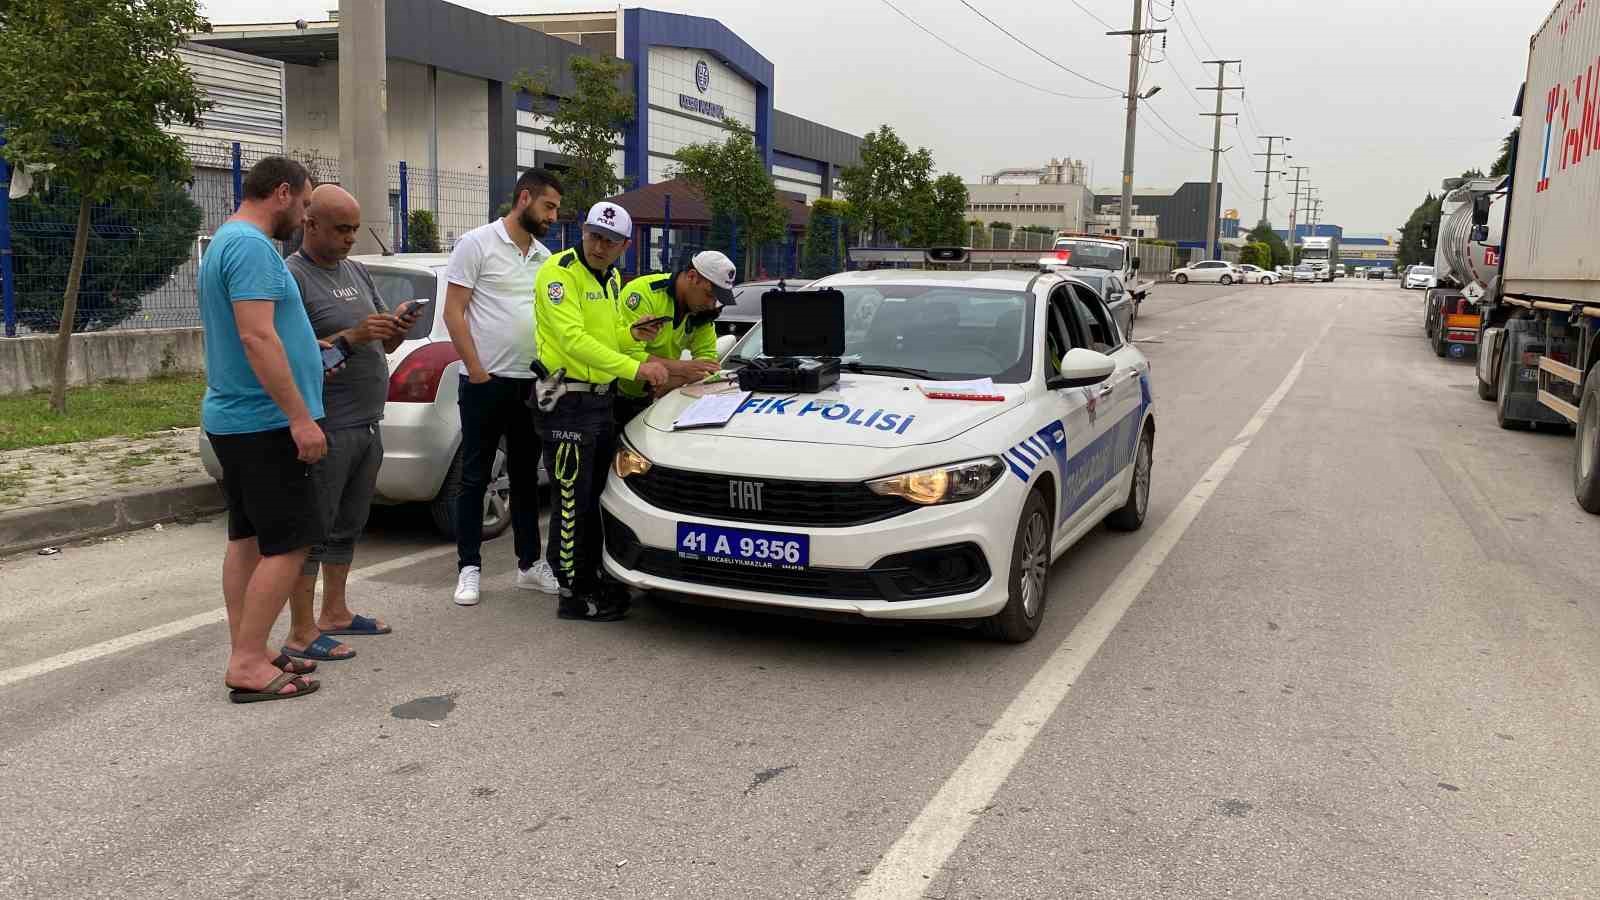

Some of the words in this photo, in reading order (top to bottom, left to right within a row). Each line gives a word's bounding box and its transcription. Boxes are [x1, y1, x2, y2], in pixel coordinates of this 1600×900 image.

[729, 480, 764, 511] FIAT
[682, 531, 707, 552] 41
[714, 534, 731, 555] A
[739, 537, 800, 563] 9356
